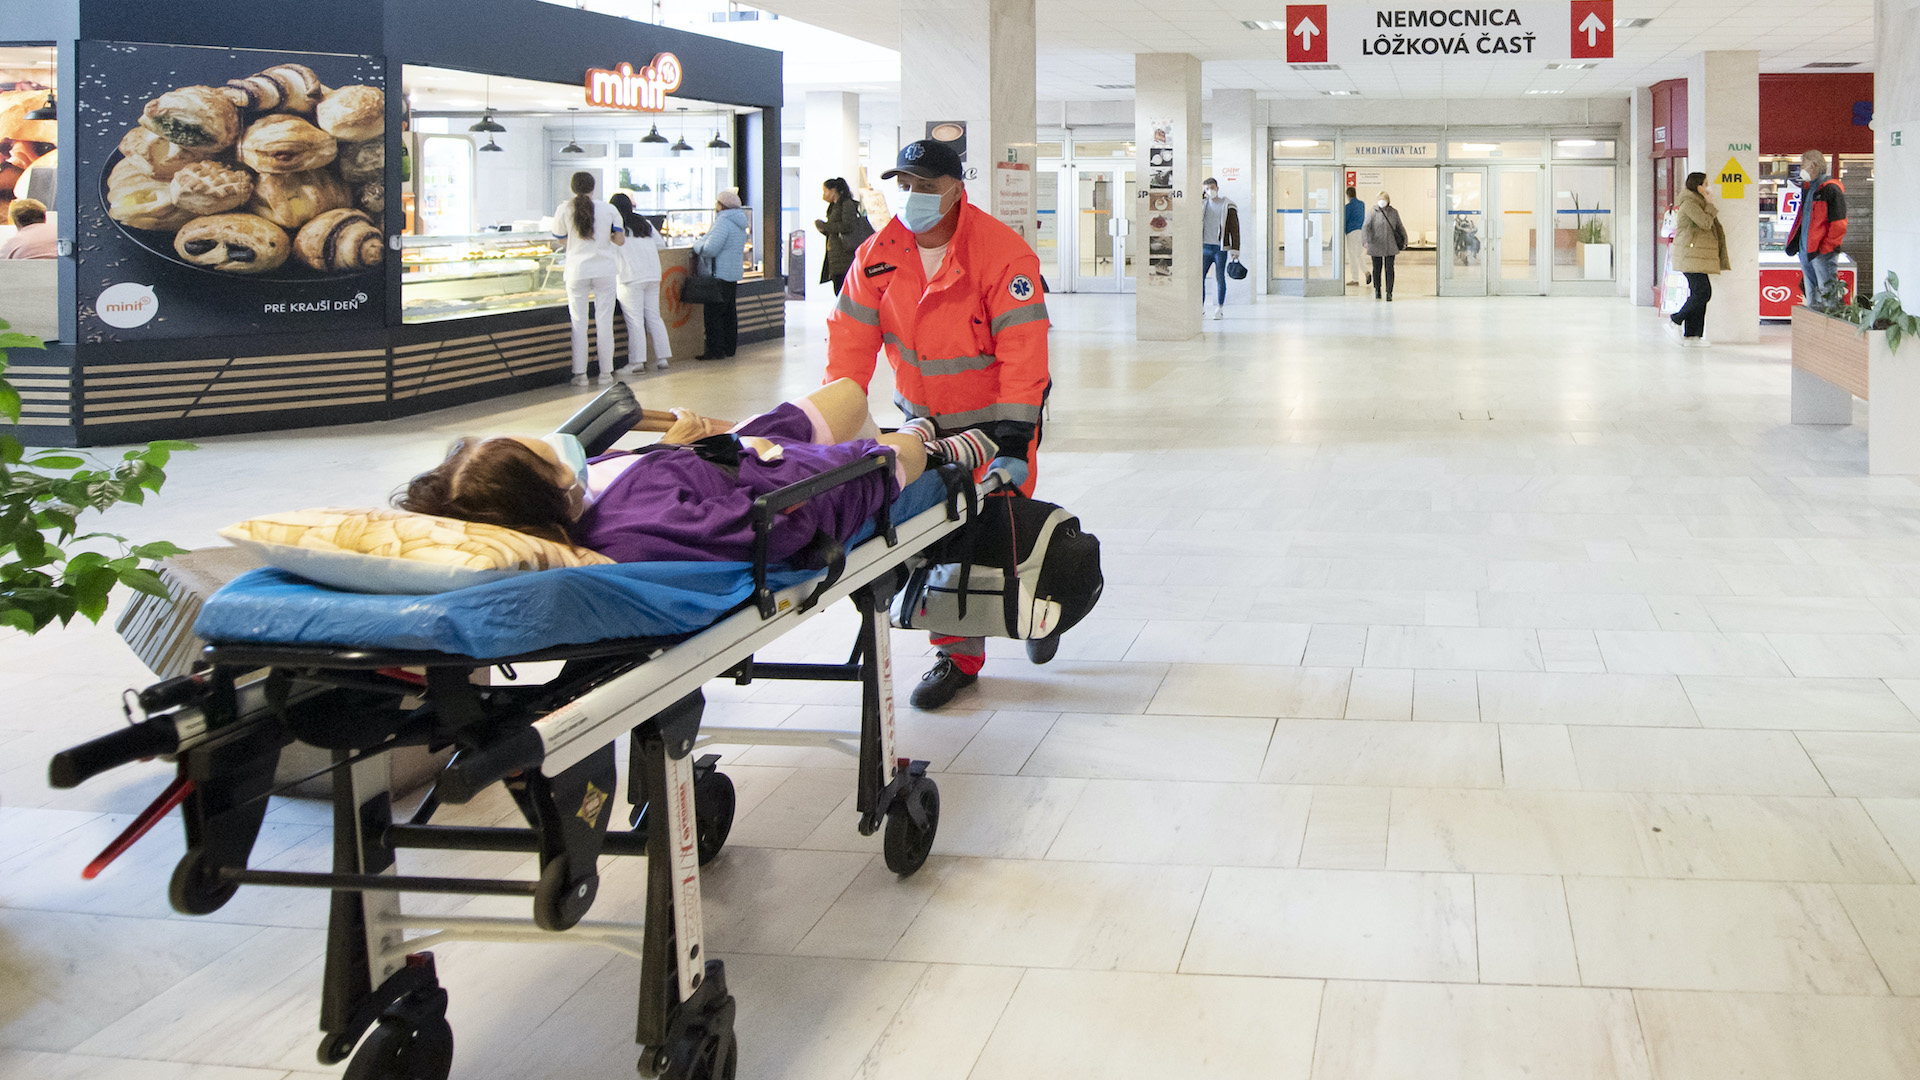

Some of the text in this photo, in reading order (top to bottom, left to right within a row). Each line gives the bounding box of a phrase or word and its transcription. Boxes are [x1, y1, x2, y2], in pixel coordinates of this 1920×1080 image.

[1376, 8, 1522, 28] NEMOCNICA
[1362, 32, 1537, 56] LÔŽKOVÁ ČASŤ
[590, 60, 670, 110] minit
[1727, 143, 1752, 152] AUN
[1721, 173, 1743, 183] MR
[106, 300, 143, 313] minit
[264, 298, 359, 314] PRE KRAJŠÍ DEŇ
